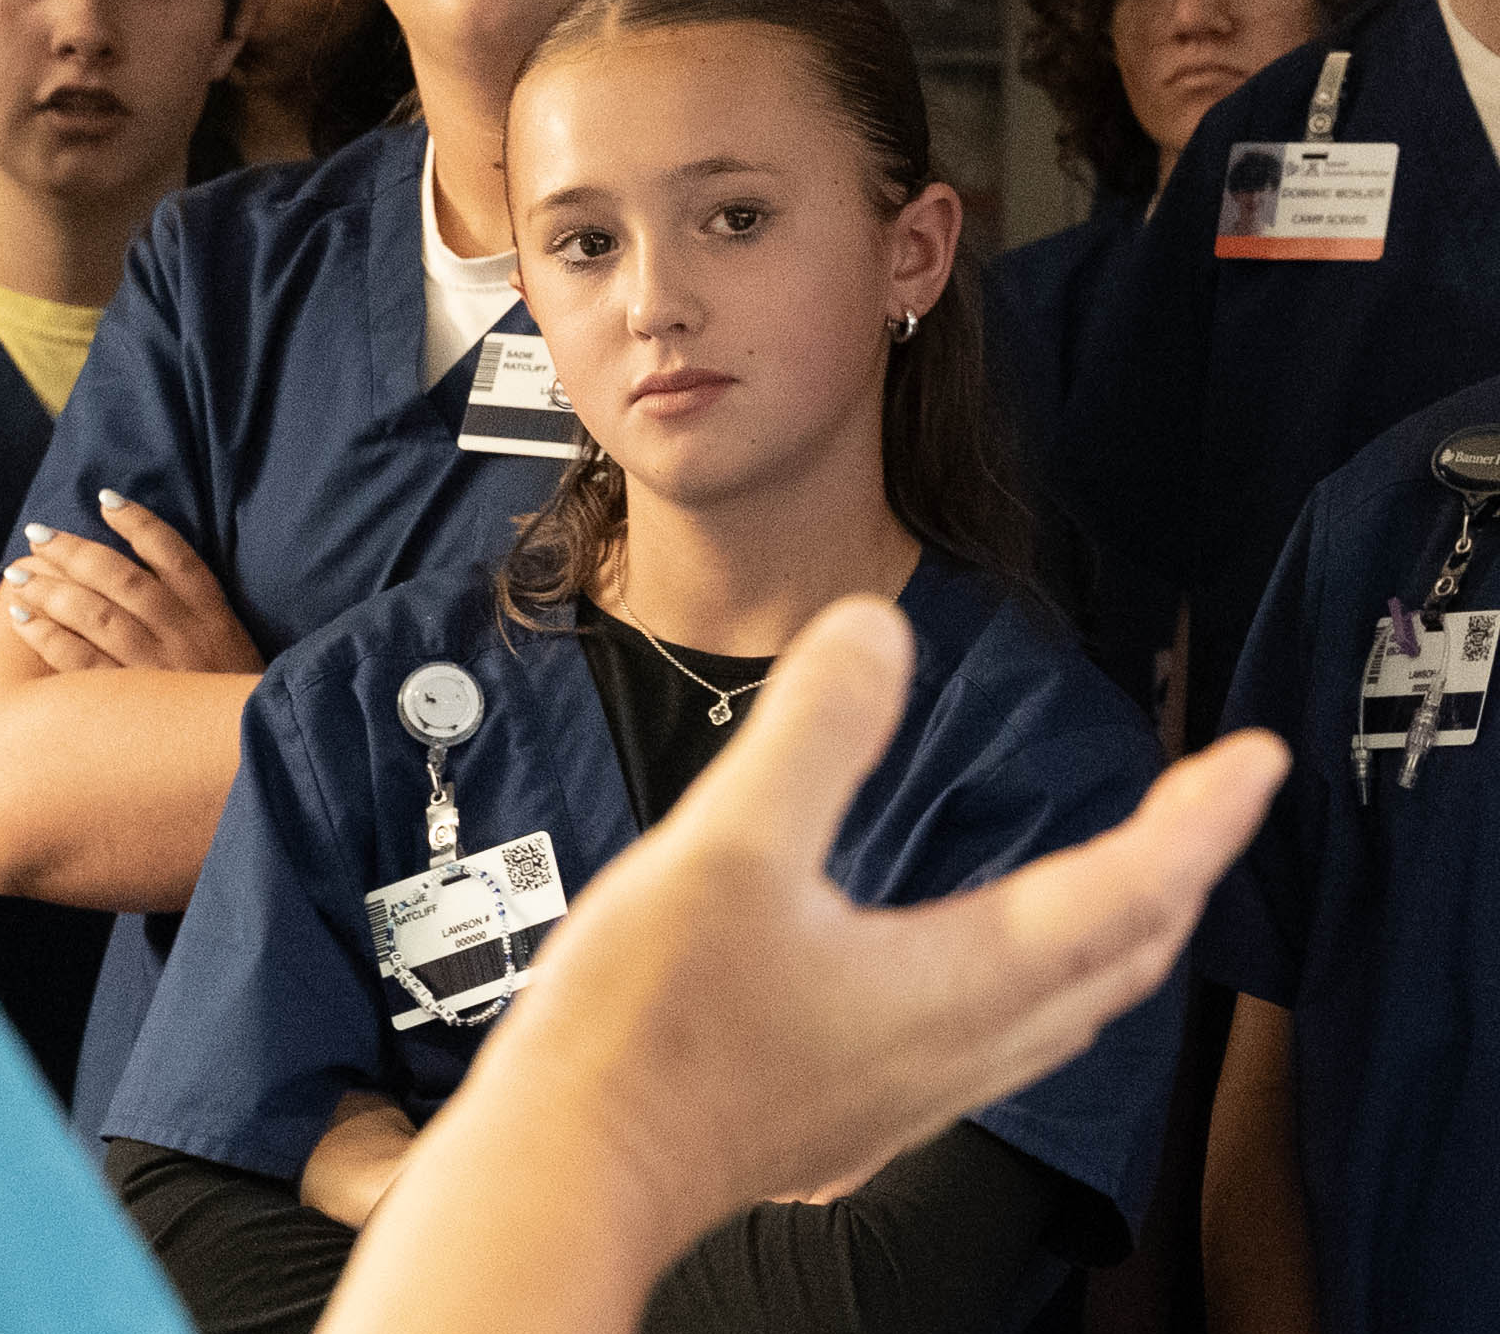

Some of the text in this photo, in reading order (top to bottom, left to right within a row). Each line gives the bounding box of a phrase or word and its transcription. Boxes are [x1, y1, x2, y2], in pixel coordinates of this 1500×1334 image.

[1291, 213, 1324, 225] CAMP
[1454, 451, 1495, 465] Banner
[393, 904, 438, 927] RATCLIFF
[441, 917, 483, 939] LAWSON
[454, 930, 487, 949] 000000
